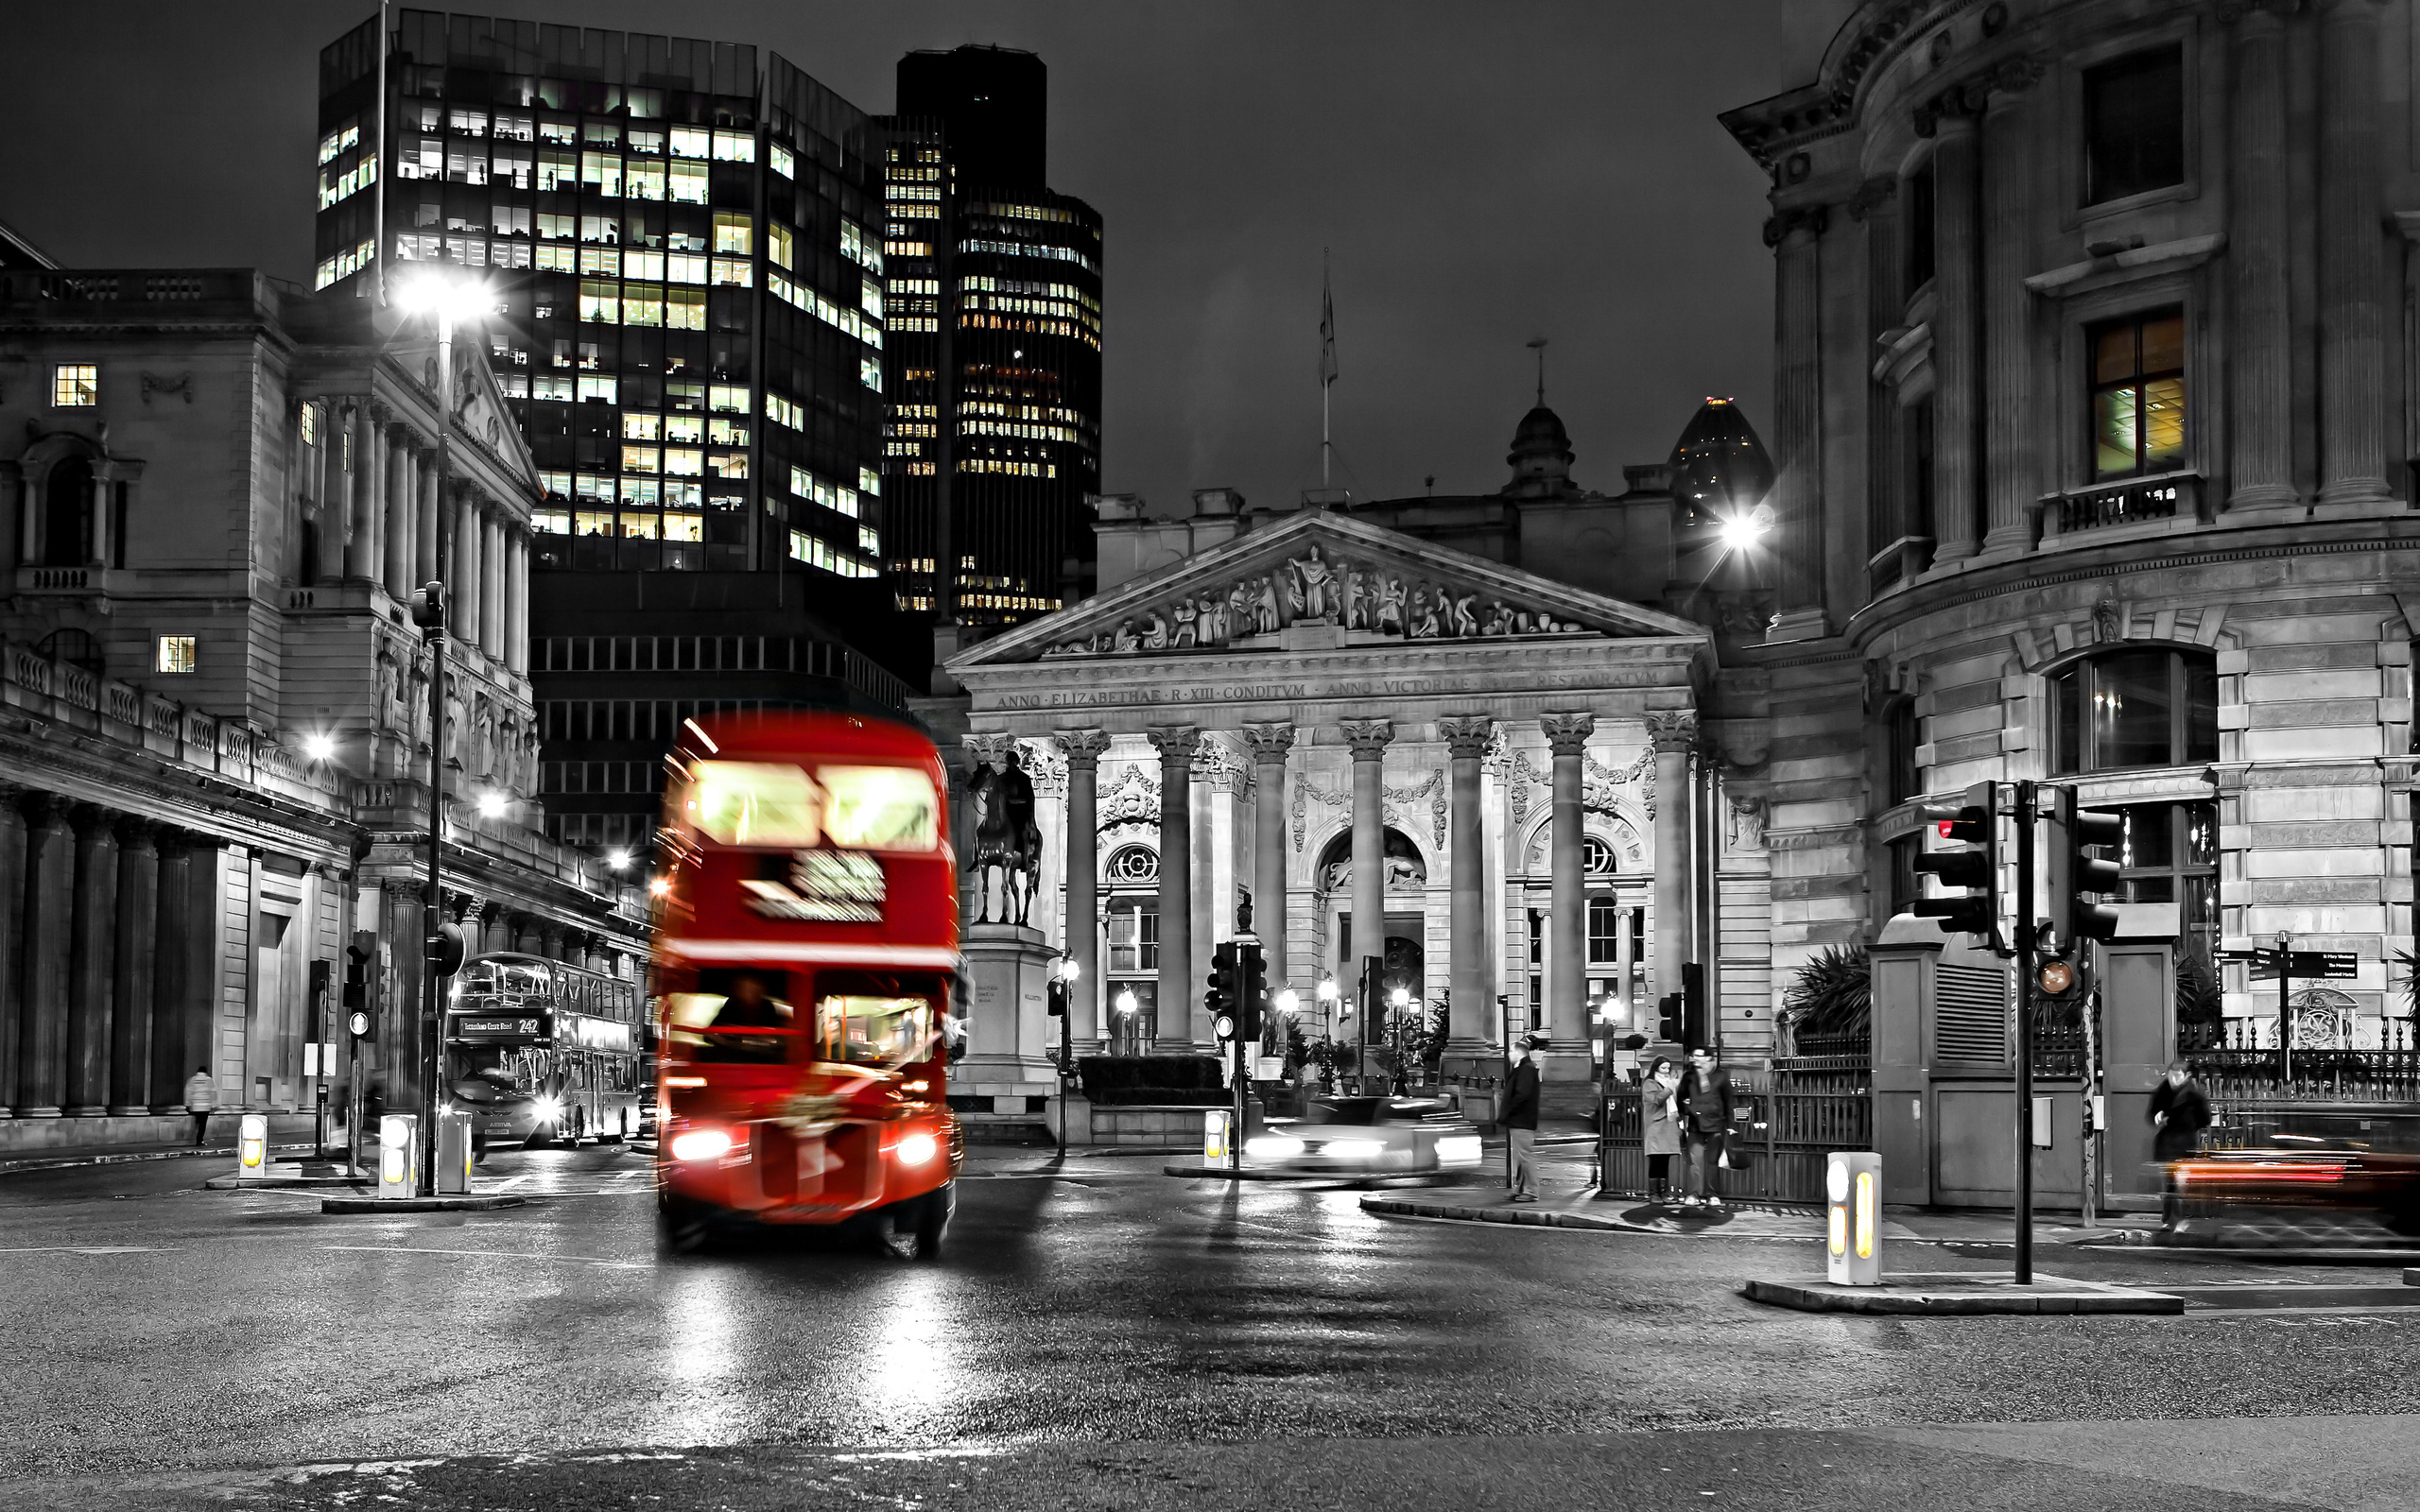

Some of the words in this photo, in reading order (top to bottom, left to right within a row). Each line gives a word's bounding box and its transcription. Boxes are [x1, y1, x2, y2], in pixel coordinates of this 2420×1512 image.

[997, 695, 1040, 708] ANNO
[1051, 690, 1161, 706] ELIZABETHAE
[1171, 689, 1182, 701] R
[1223, 684, 1305, 698] CONDITVM
[1325, 681, 1372, 695] ANNO
[1383, 679, 1471, 693] VICTORIAE
[1536, 671, 1659, 686] RESTAVRATVM
[519, 1019, 538, 1034] 242
